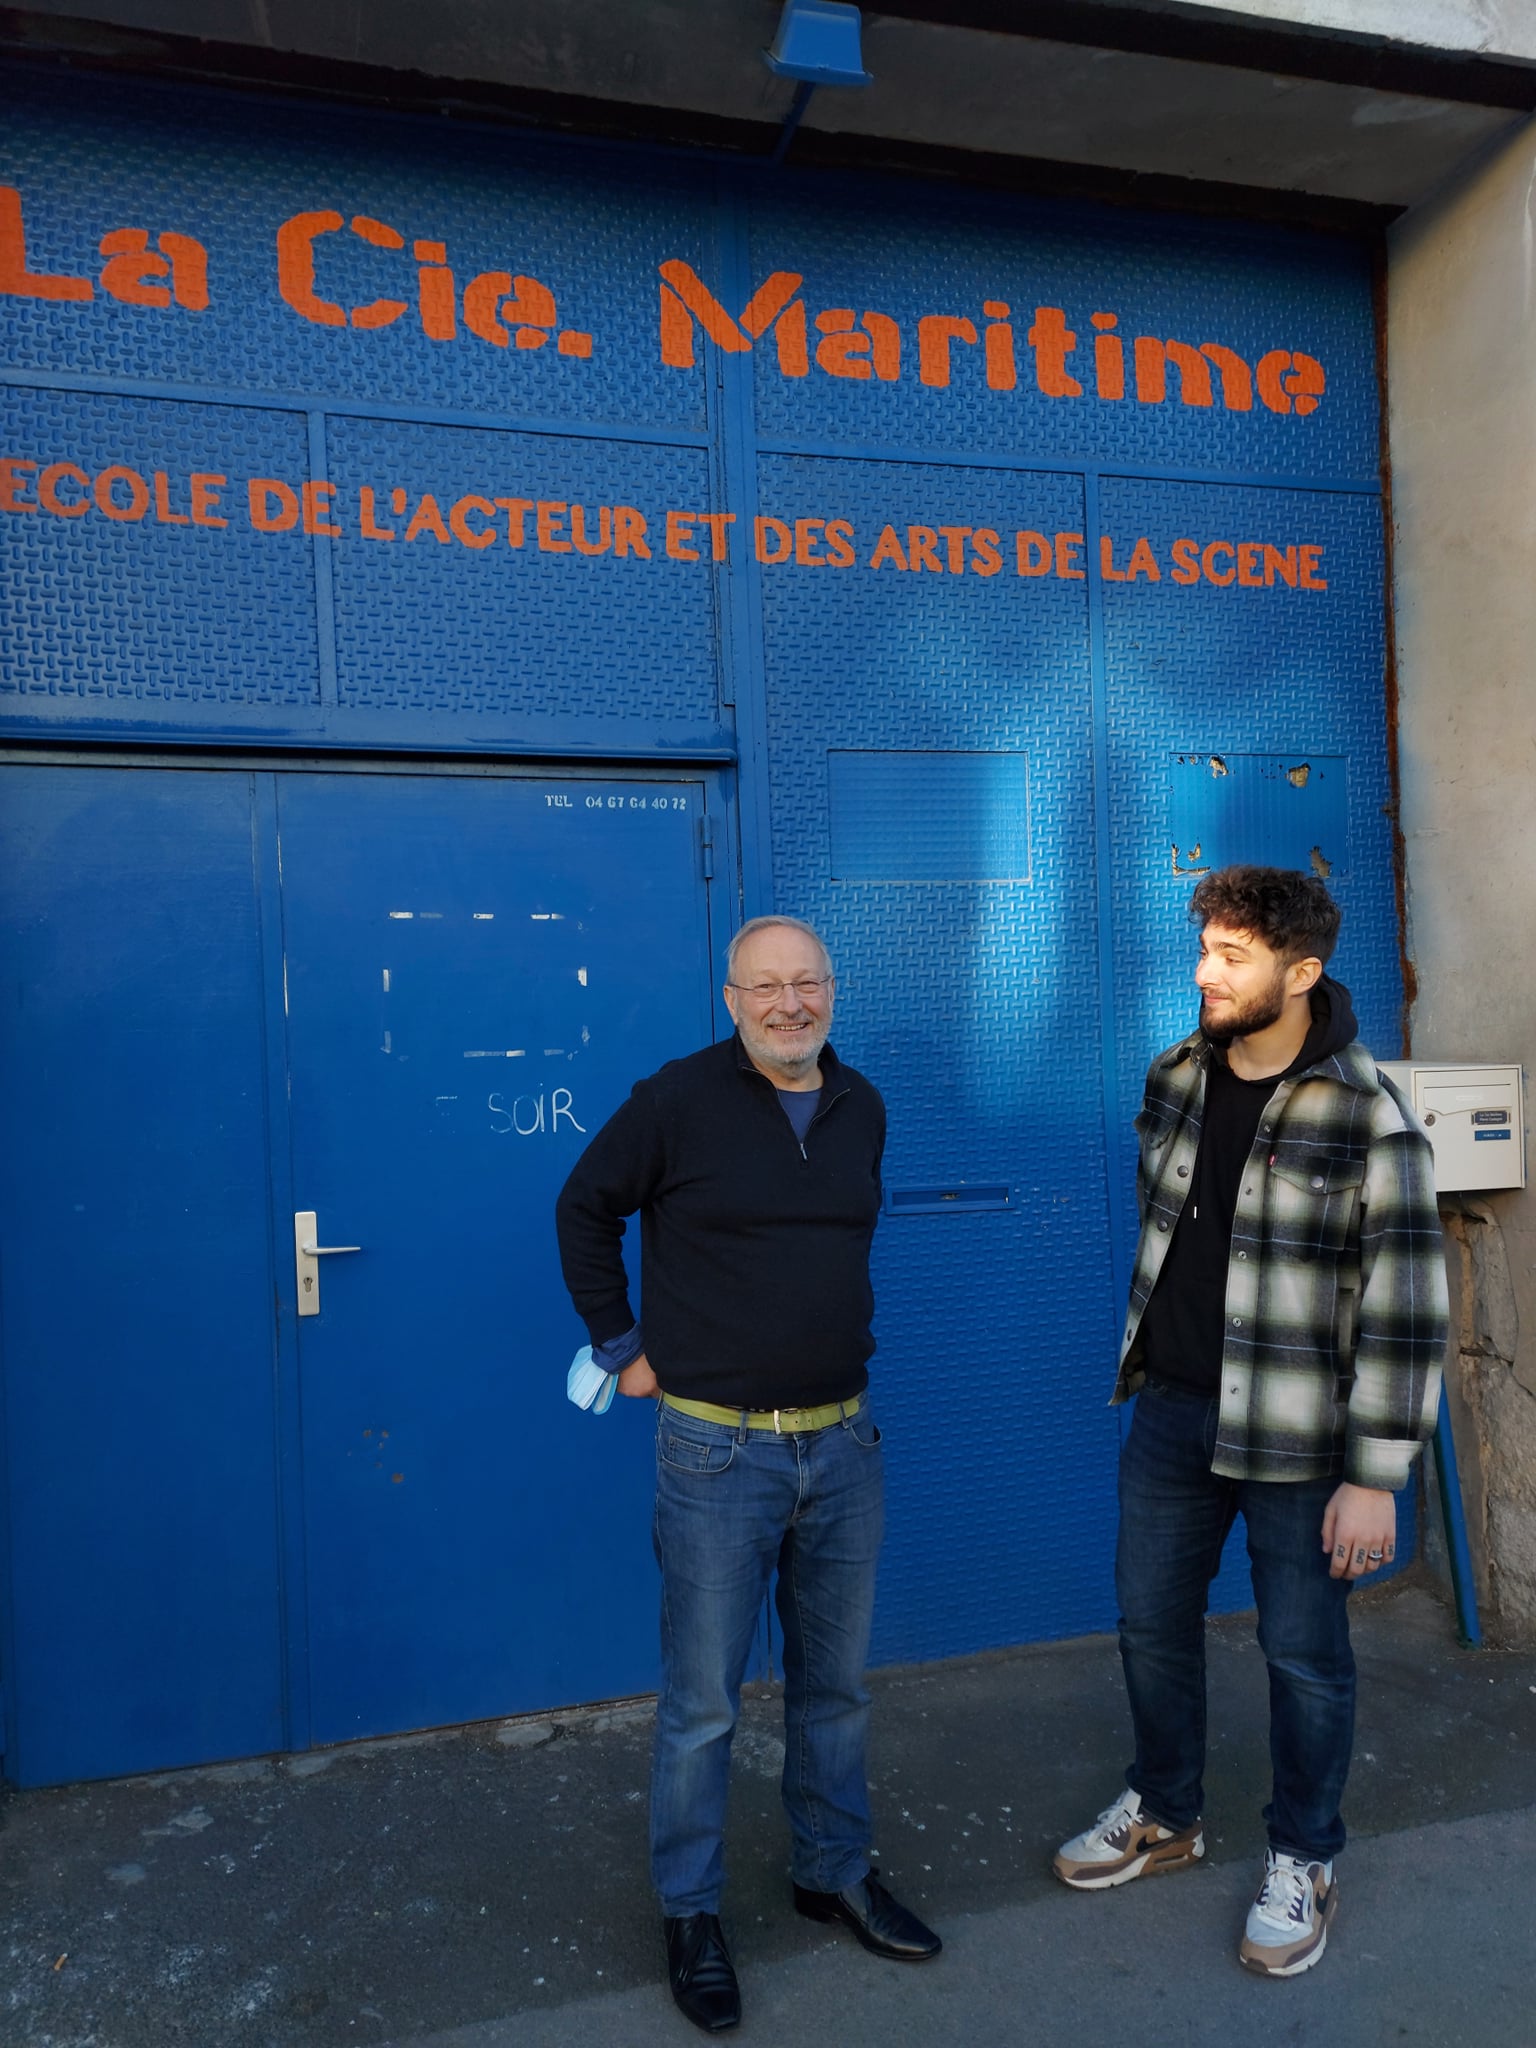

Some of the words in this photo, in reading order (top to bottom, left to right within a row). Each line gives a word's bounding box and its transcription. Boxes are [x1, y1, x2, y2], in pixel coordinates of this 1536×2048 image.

[0, 186, 209, 310] La
[277, 210, 592, 358] Cie.
[659, 259, 1325, 415] Maritime
[0, 459, 227, 527] ECOLE
[249, 479, 341, 536] DE
[360, 487, 651, 558] L'ACTEUR
[666, 512, 736, 560] ET
[754, 517, 855, 567] DES
[871, 526, 1002, 576] ARTS
[1017, 531, 1084, 578] DE
[1101, 536, 1160, 581] LA
[1172, 539, 1327, 589] SCENE
[545, 794, 573, 807] TEL
[585, 796, 603, 808] 04
[607, 796, 625, 808] 67
[630, 797, 647, 809] 64
[651, 798, 668, 809] 40
[671, 797, 687, 810] 72
